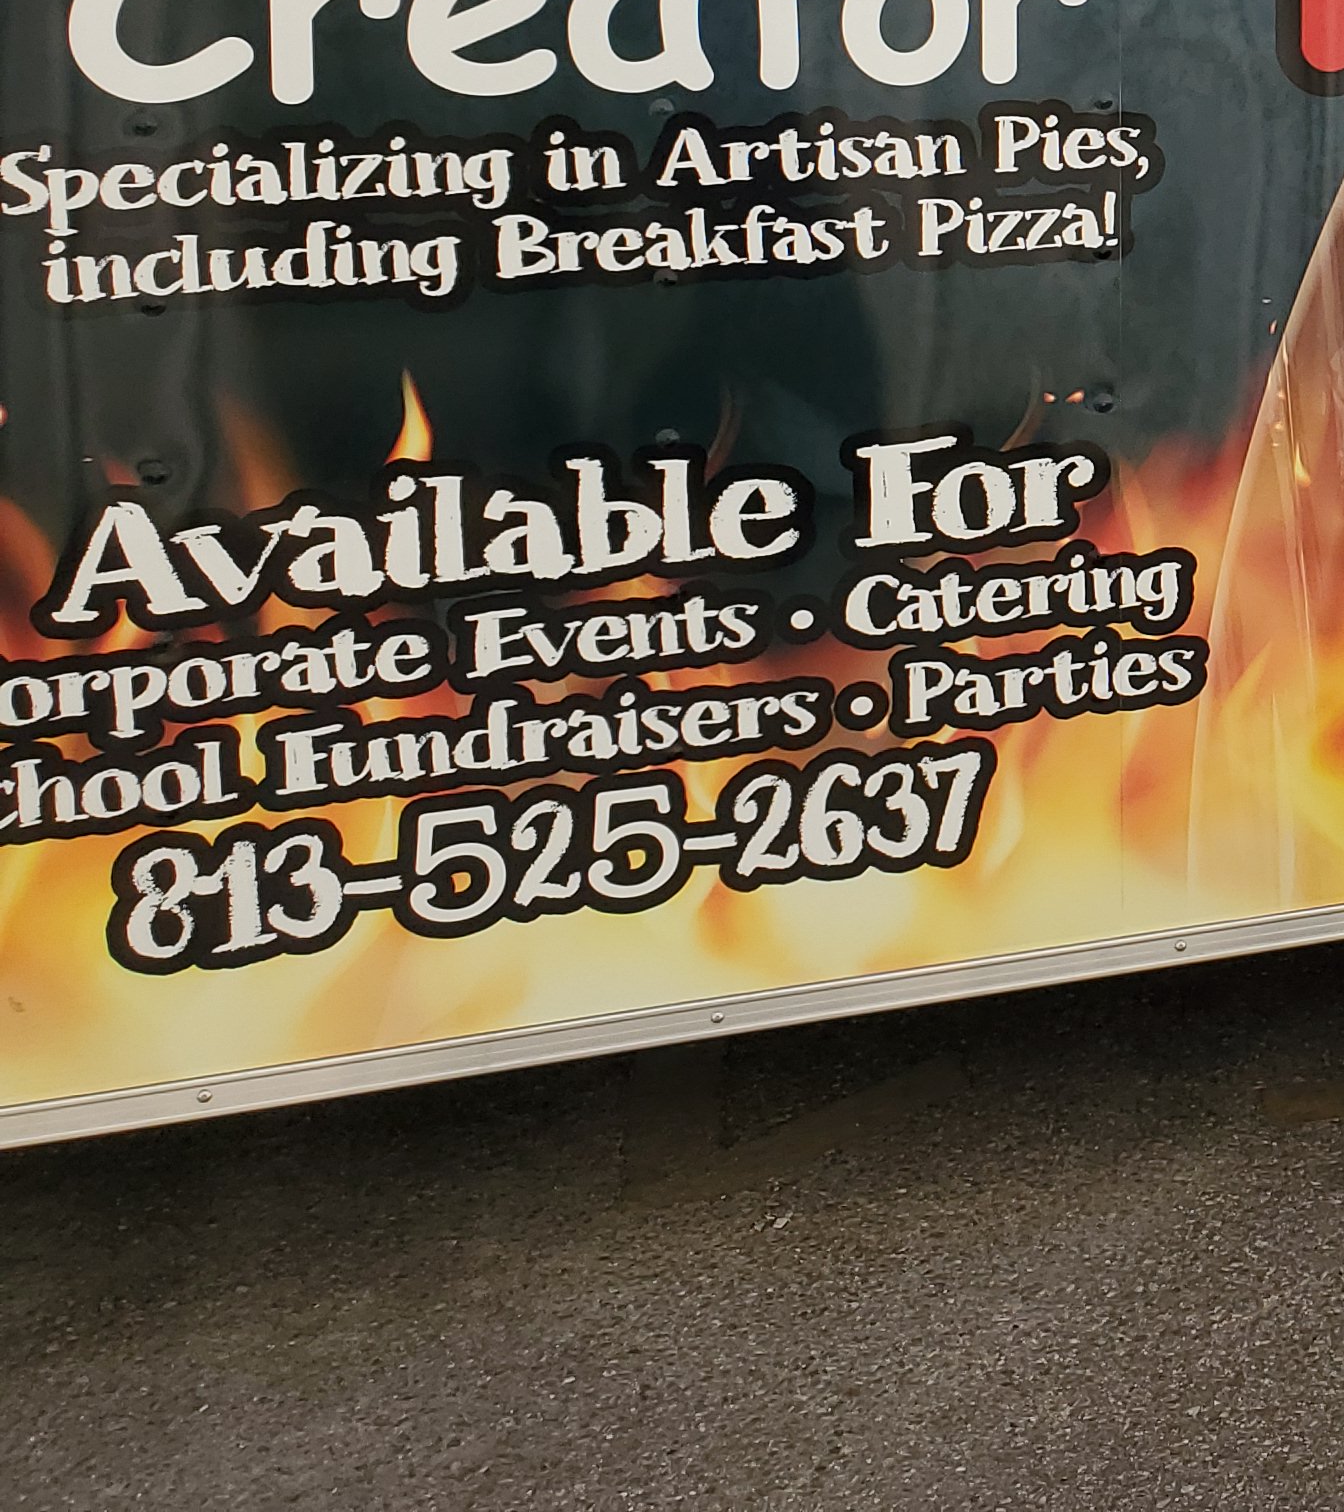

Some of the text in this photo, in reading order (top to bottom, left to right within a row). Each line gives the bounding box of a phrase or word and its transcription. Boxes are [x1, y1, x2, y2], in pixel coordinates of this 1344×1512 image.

[0, 115, 1148, 236] Specializing in Artisan Pies,
[42, 192, 1118, 303] including Breakfast Pizza!
[52, 436, 1094, 622] Available For
[0, 555, 1181, 738] orporate Events Catering
[0, 641, 1194, 829] hool Fundraisers Parties
[128, 752, 980, 958] 813-525-2637
